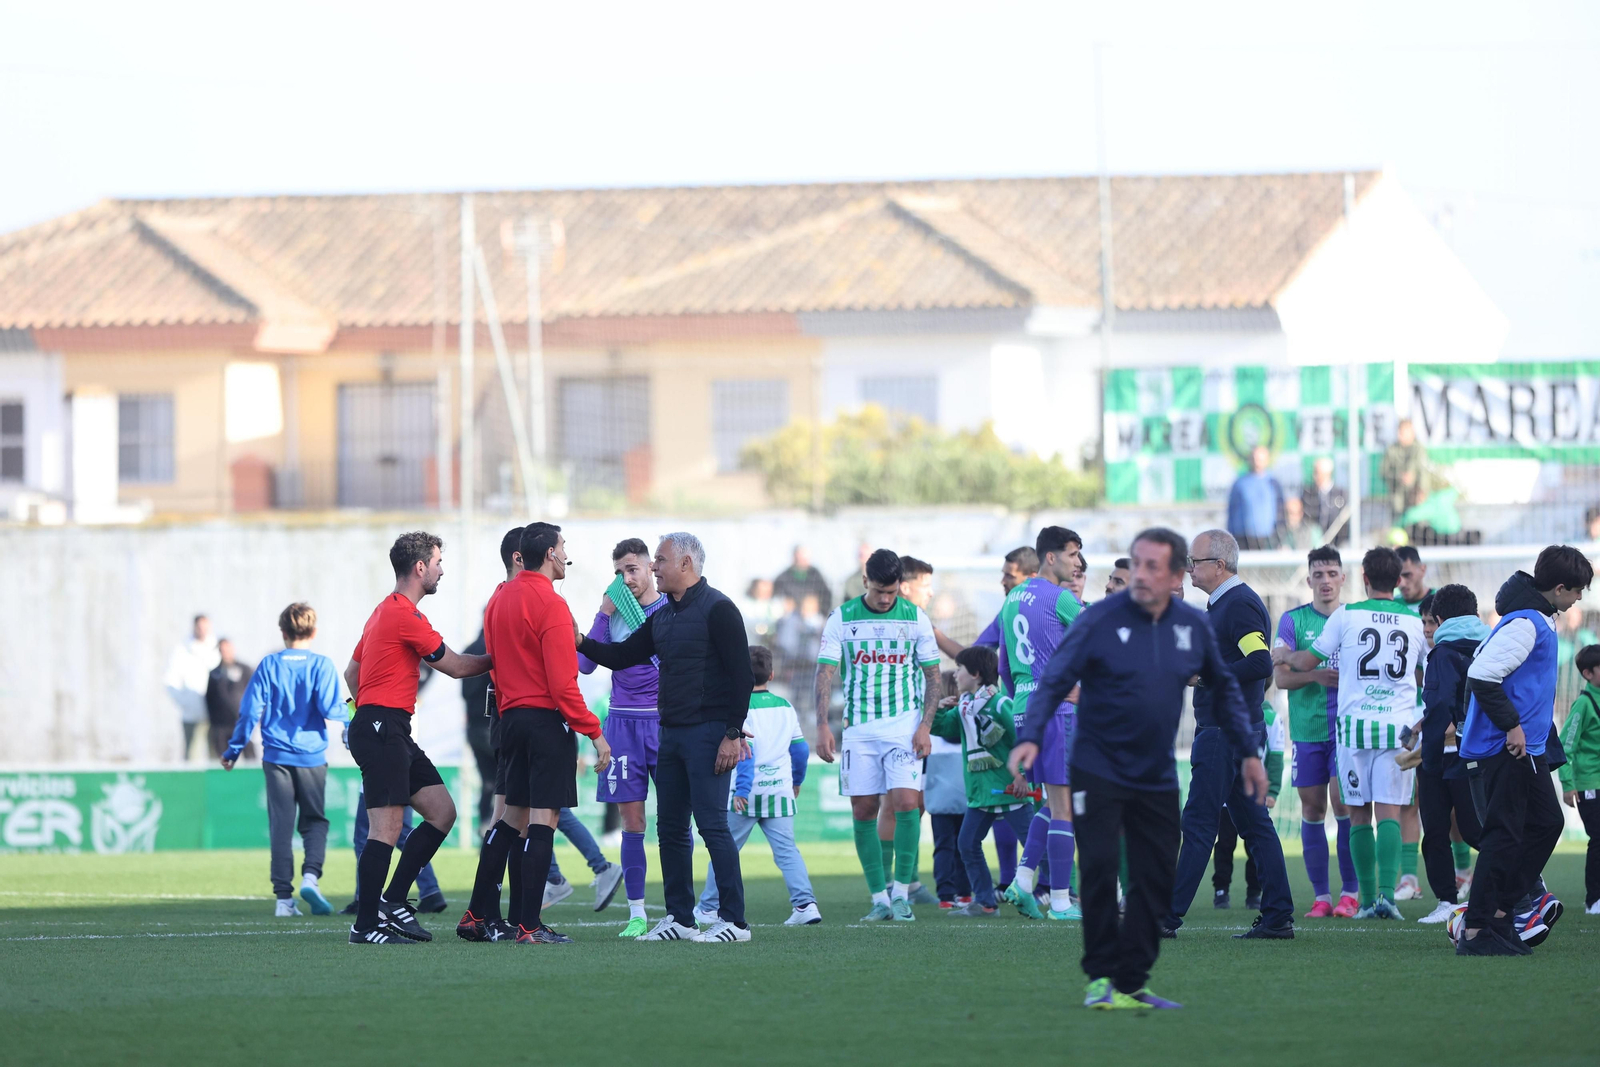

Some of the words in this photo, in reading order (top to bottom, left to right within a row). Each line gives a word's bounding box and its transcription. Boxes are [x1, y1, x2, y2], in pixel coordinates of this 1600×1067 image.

[1411, 382, 1600, 440] MARE
[1007, 590, 1037, 607] JUANPE
[1371, 612, 1400, 626] COKE
[1012, 613, 1036, 665] 8
[852, 649, 907, 665] Solear
[1357, 627, 1409, 682] 23
[607, 755, 628, 780] 21
